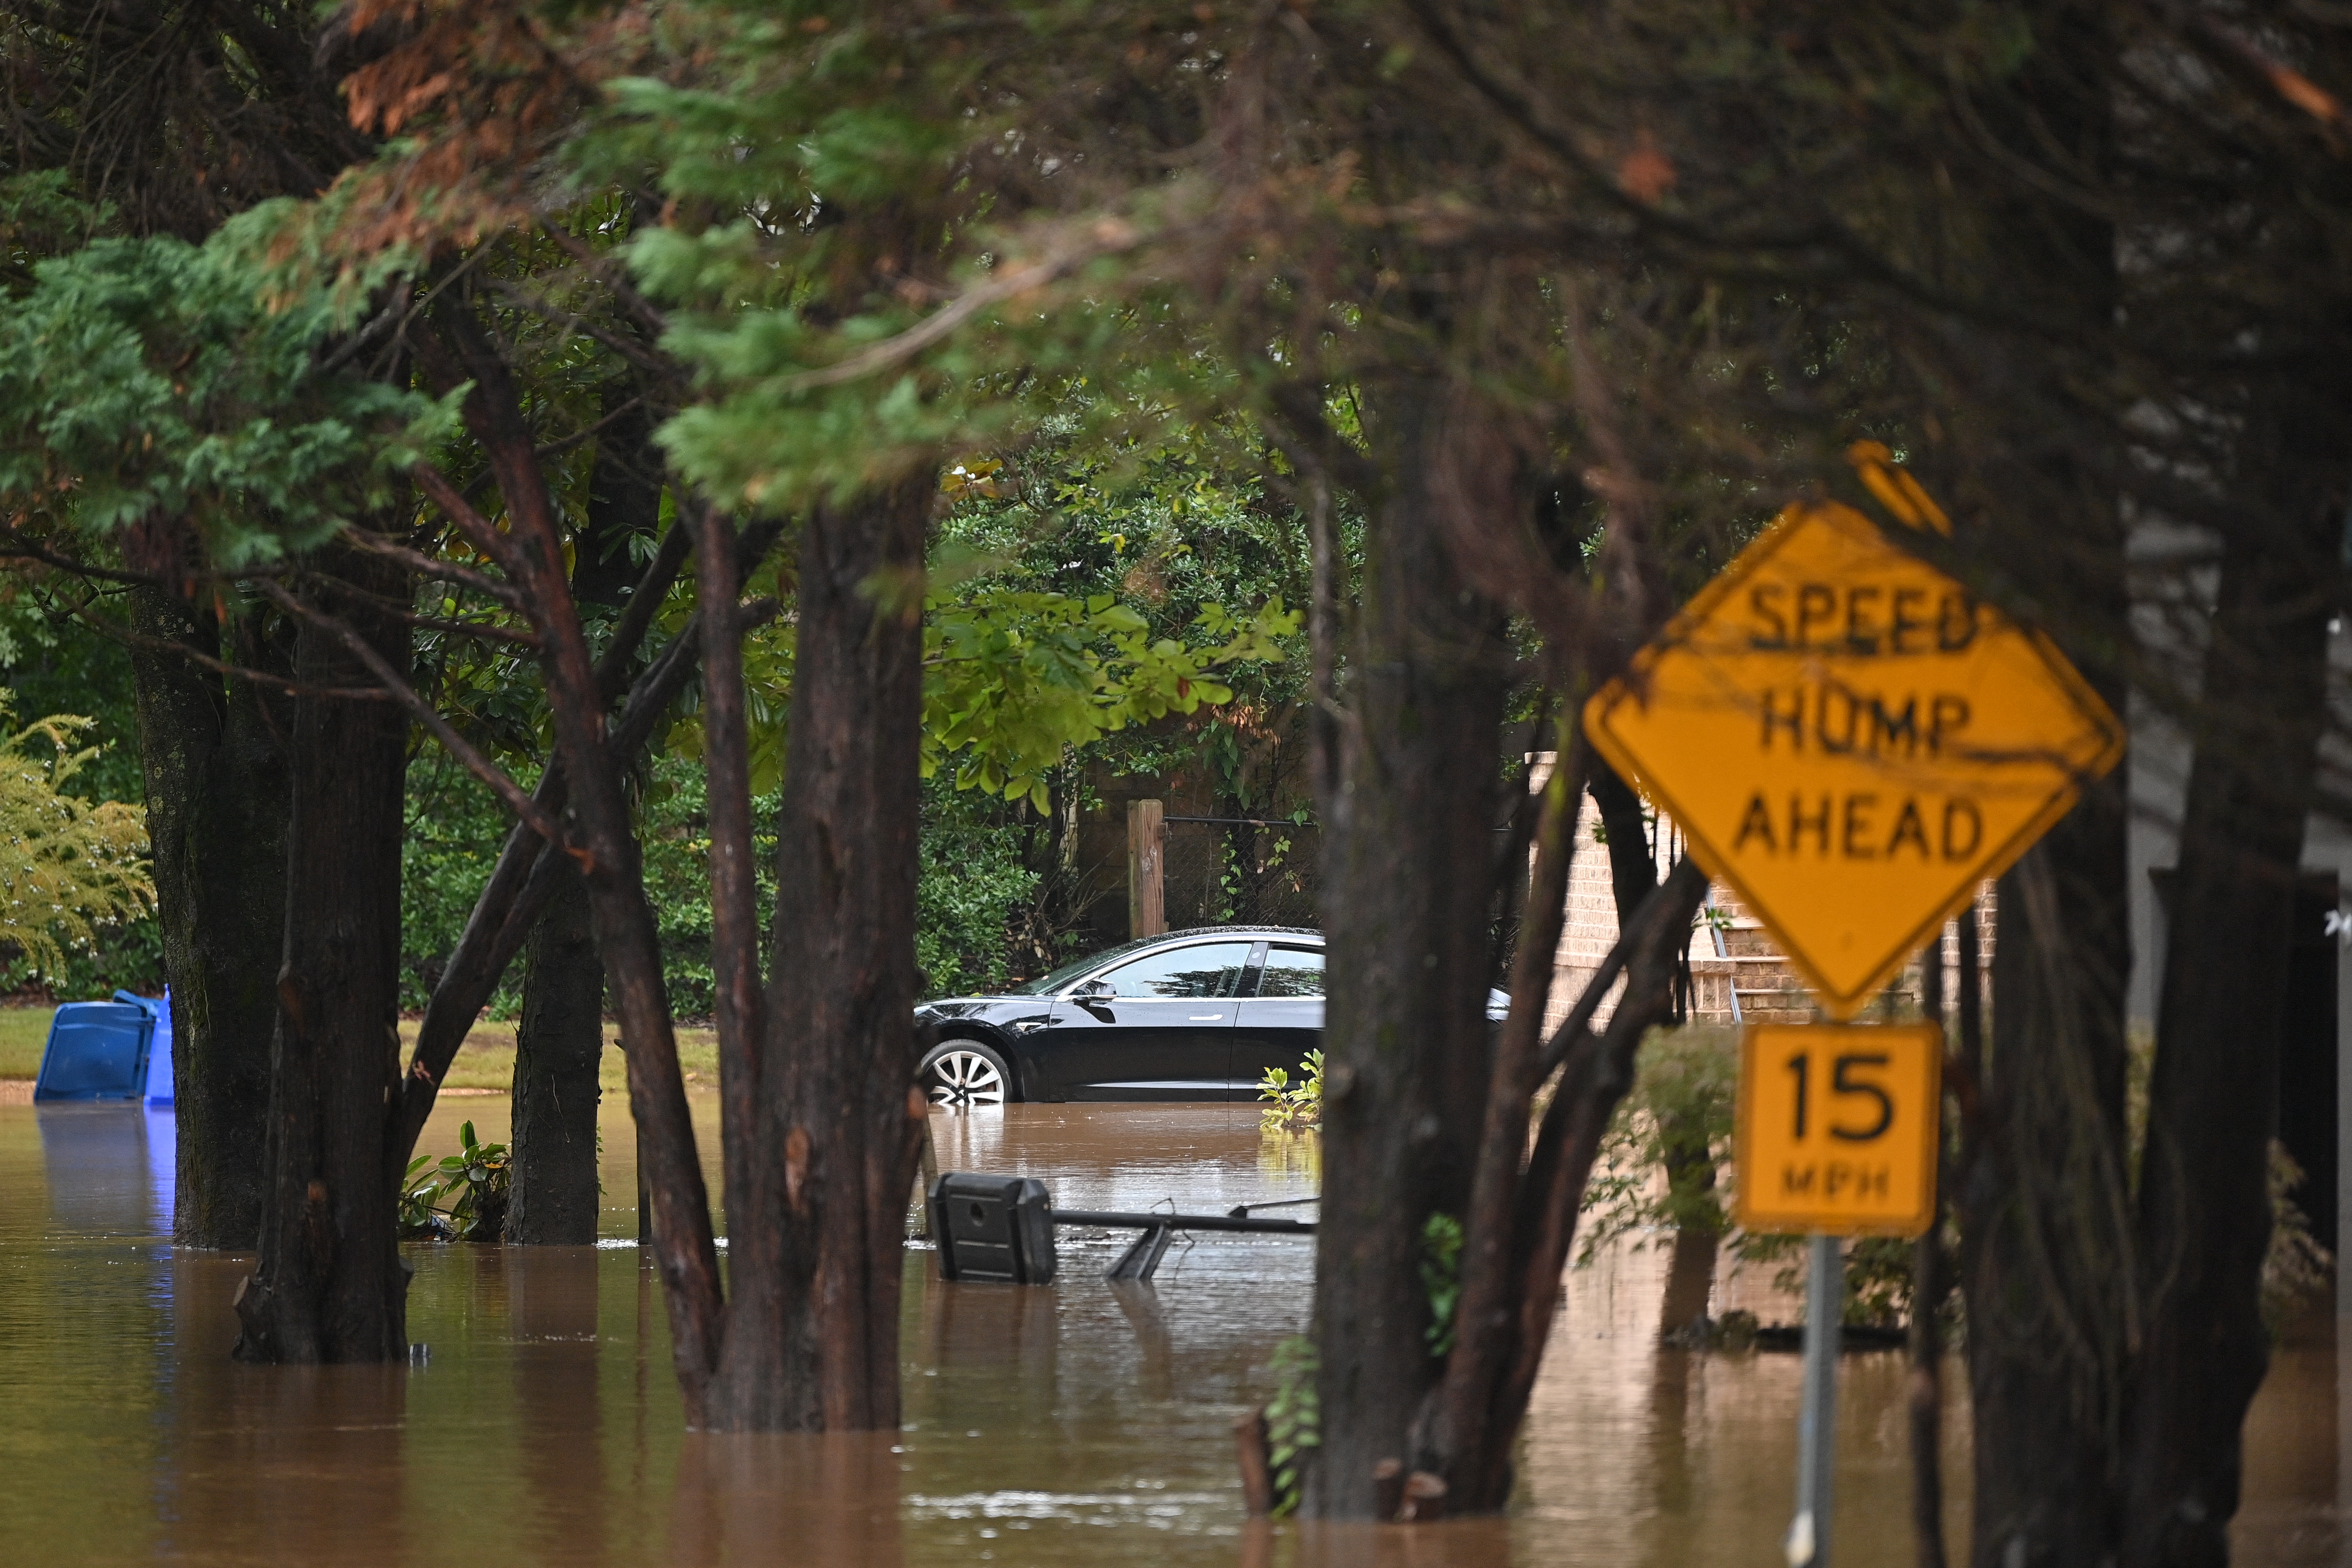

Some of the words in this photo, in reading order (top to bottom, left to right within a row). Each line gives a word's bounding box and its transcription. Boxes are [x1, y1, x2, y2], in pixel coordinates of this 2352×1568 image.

[1748, 584, 1979, 655] SPEED
[1759, 683, 1972, 754] HUMP
[1734, 793, 1984, 862] AHEAD
[1786, 1051, 1894, 1142] 15
[1781, 1162, 1890, 1200] MPH
